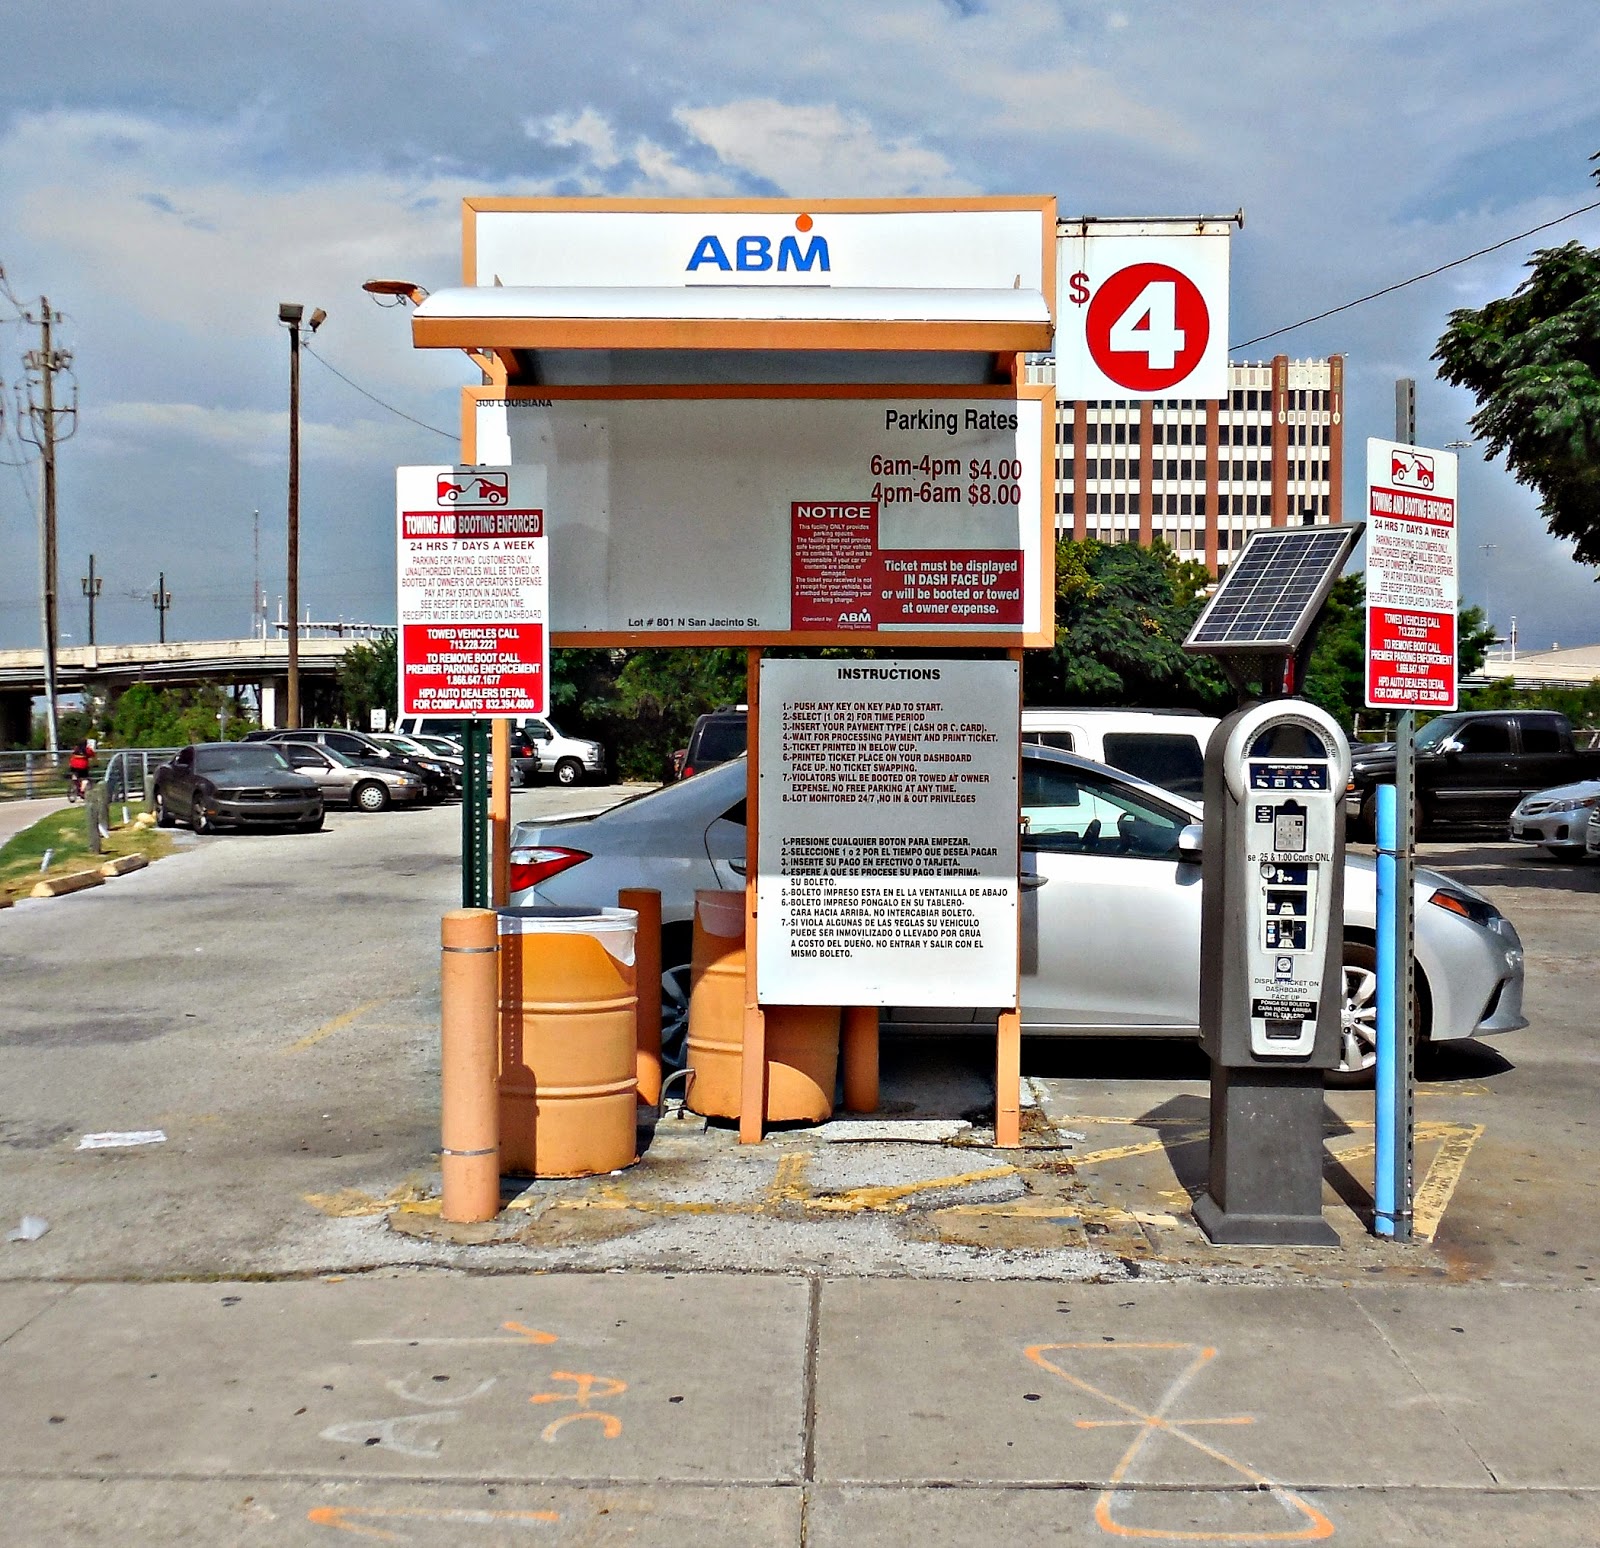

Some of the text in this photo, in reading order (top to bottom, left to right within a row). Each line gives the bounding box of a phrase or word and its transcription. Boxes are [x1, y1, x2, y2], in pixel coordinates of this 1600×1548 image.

[686, 236, 830, 271] ABM
[1069, 270, 1185, 369] $ 4
[886, 409, 1018, 435] Parking Rates
[871, 455, 1022, 481] 6am-4pm $4.00
[872, 482, 1021, 508] 4pm-6am $8.00
[1372, 491, 1452, 522] TOWING AND BOOTING ENFORCED
[798, 507, 871, 518] NOTICE
[405, 515, 539, 534] TOWING AND BOOTING ENFORCED
[1375, 520, 1449, 539] 24 HRS 7 DAYS A WEEK
[410, 541, 534, 550] 24 HRS 7 DAYS A WEEK
[413, 556, 532, 564] PARKING FOR PAYING CUSTOMERS ONLY.
[885, 560, 1017, 574] Ticket must be displayed
[904, 574, 997, 585] IN DASH FACE UP
[882, 589, 1019, 600] or will be booted or towed
[902, 603, 998, 616] at owner expense.
[629, 618, 760, 626] Lot # 801 N San Jacinto St.
[839, 613, 870, 621] ABM
[1385, 613, 1440, 628] TOWED VEHICLES CALL
[427, 629, 519, 639] TOWED VEHICLES CALL
[427, 654, 519, 663] TO REMOVE BOOT CALL
[406, 664, 540, 674] PREMIER PARKING ENFORCEMENT
[838, 669, 940, 680] INSTRUCTIONS
[438, 689, 459, 698] AUTO
[461, 689, 498, 698] DEALERS
[501, 689, 527, 698] DETAIL
[794, 703, 816, 711] PUSH
[818, 703, 834, 711] ANY
[836, 703, 851, 711] KEY
[854, 703, 865, 711] ON
[868, 703, 883, 711] KEY
[885, 703, 900, 711] PAD
[904, 703, 913, 711] TO
[916, 703, 943, 711] START.
[792, 764, 917, 772] FACE UP. NO TICKET SWAPPING.
[792, 784, 956, 792] EXPENSE. NO FREE PARKING AT ANY TIME.
[832, 838, 877, 846] CUALQUIER
[879, 838, 906, 846] BOTON
[909, 838, 929, 846] PARA
[932, 838, 970, 846] EMPEZAR.
[1271, 853, 1274, 861] &
[1294, 853, 1313, 861] Coins
[791, 878, 837, 886] SU BOLETO.
[824, 889, 859, 897] IMPRESO
[861, 889, 881, 897] ESTA
[884, 889, 893, 897] EN
[896, 889, 905, 897] EL
[908, 889, 917, 897] LA
[920, 889, 967, 897] VENTANILLA
[970, 889, 979, 897] DE
[982, 889, 1008, 897] ABAJO
[791, 950, 852, 958] MISMO BOLETO.
